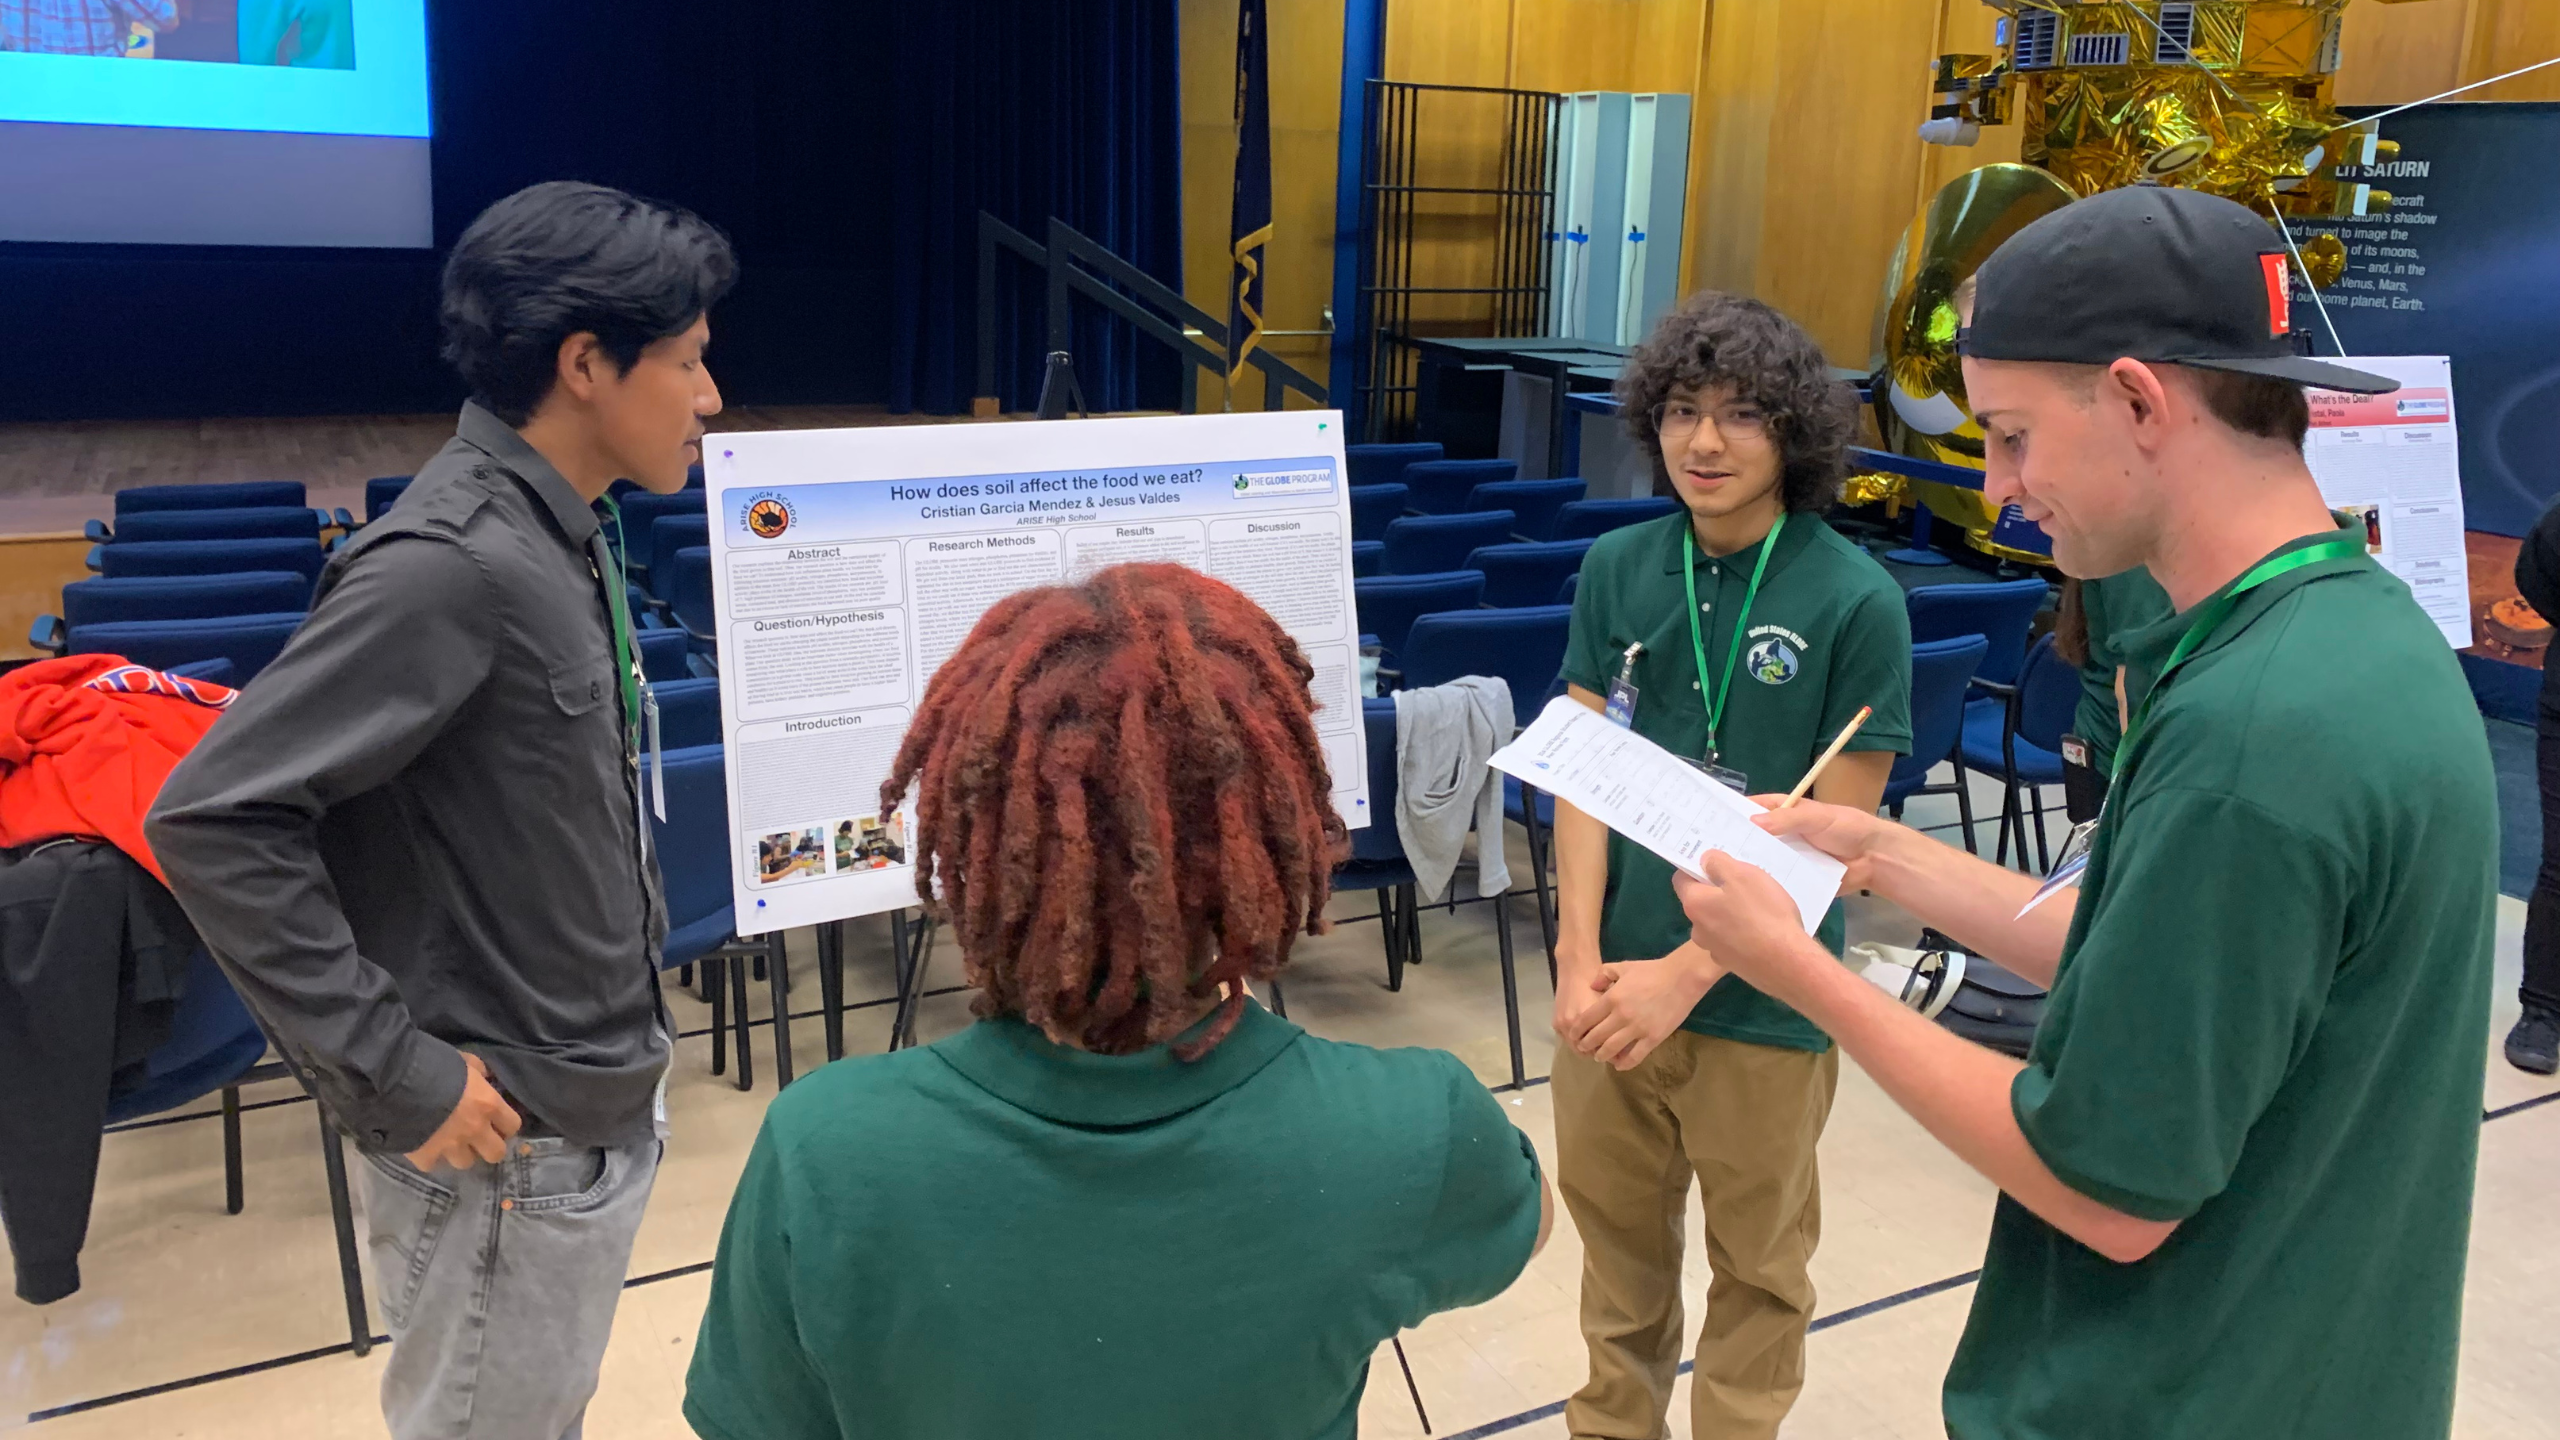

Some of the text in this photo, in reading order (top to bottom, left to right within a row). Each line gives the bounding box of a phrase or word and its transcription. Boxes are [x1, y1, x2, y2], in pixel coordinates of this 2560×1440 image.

[2391, 195, 2425, 207] ecraft
[2393, 212, 2437, 225] shadow
[2341, 227, 2352, 238] to
[2354, 228, 2388, 242] image
[2391, 229, 2409, 241] the
[2351, 244, 2363, 256] of
[2364, 245, 2378, 257] its
[2380, 247, 2419, 260] moons,
[2368, 263, 2392, 275] and,
[2394, 264, 2405, 275] in
[2408, 264, 2426, 276] the
[2341, 277, 2376, 291] Venus,
[2379, 279, 2409, 292] Mars,
[2318, 292, 2348, 305] home
[2351, 295, 2389, 308] planet,
[2392, 297, 2426, 311] Earth.
[2310, 394, 2374, 405] What's the Deal?
[890, 469, 1203, 501] How does soil affect the food we eat?
[1250, 473, 1330, 487] THE GLOBE PROGRAM
[740, 491, 798, 531] ARISE HIGH SCHOOL
[920, 492, 1181, 519] Cristian Garcia Mendez & Jesus Valdes
[1016, 512, 1097, 526] ARISE High School
[1116, 526, 1155, 538] Results
[1247, 521, 1301, 533] Discussion
[928, 535, 1036, 552] Research Methods
[787, 547, 841, 560] Abstract
[753, 610, 885, 632] Question/Hypothesis
[1748, 625, 1769, 639] United
[1769, 625, 1791, 638] States
[1613, 689, 1630, 704] JPL
[785, 714, 862, 733] Introduction
